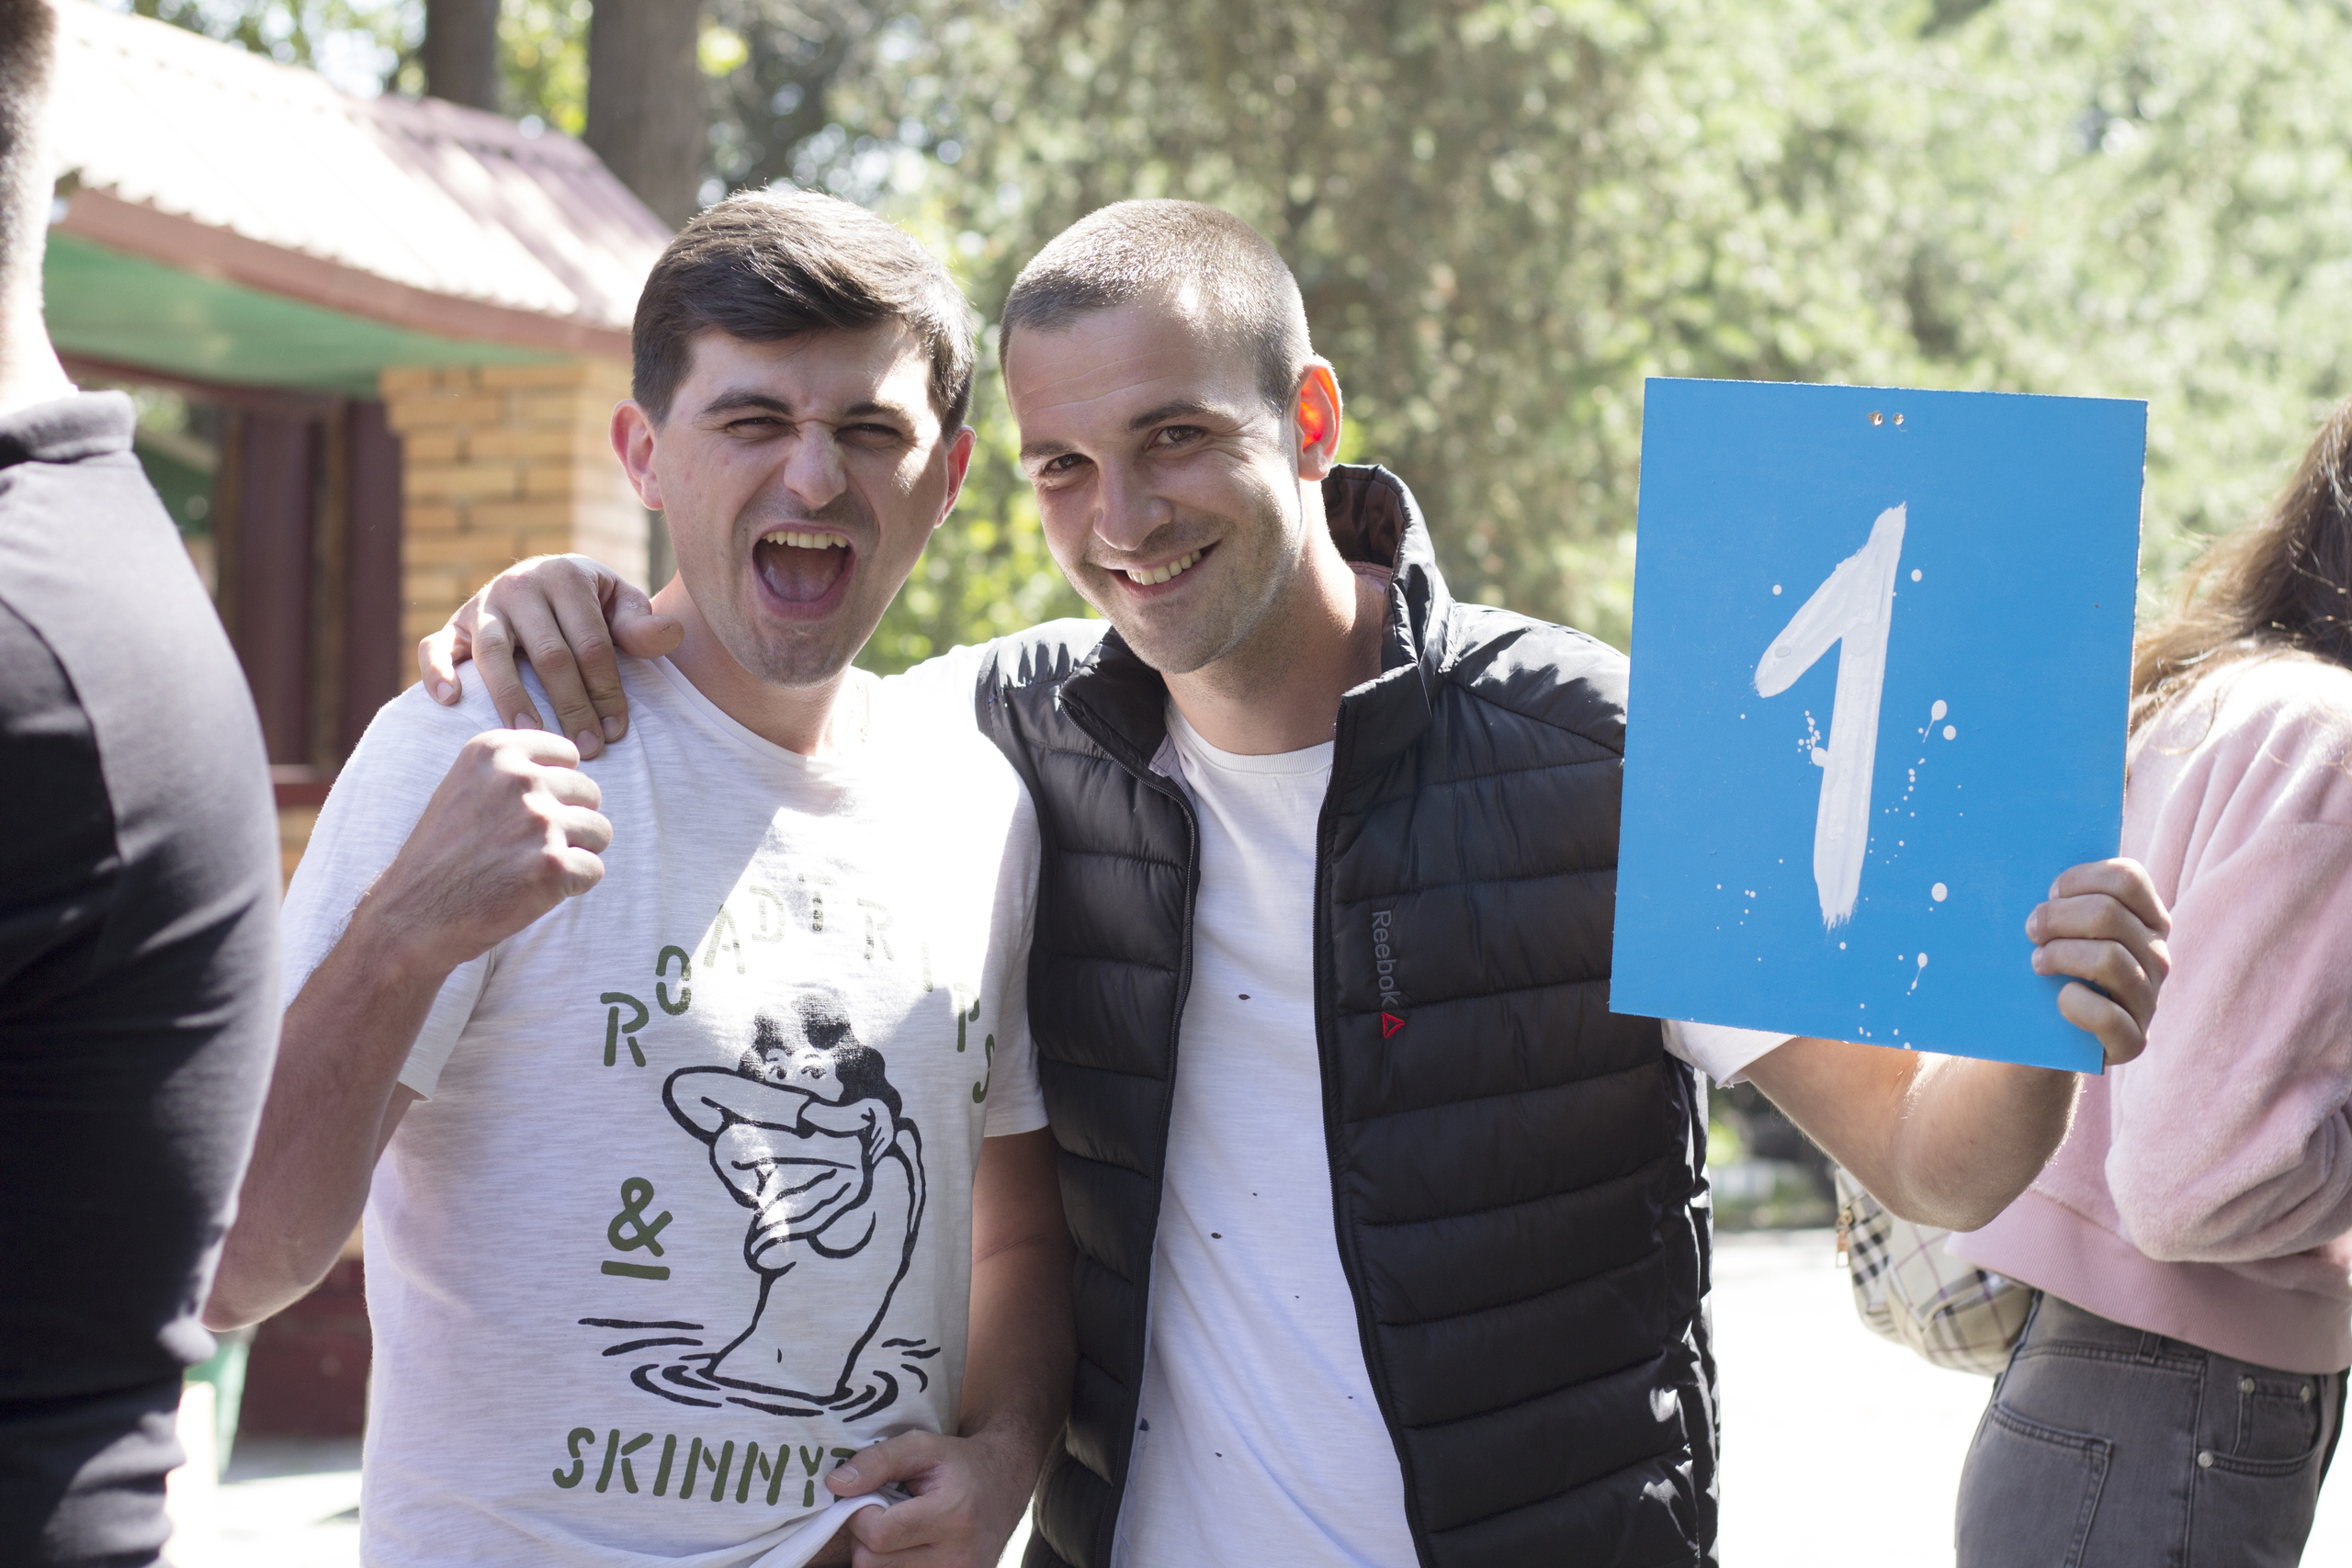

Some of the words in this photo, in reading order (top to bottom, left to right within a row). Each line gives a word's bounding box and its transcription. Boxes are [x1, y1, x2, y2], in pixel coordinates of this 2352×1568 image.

[1754, 501, 1907, 931] 1
[1372, 910, 1401, 1008] Reebok
[601, 1177, 673, 1280] &
